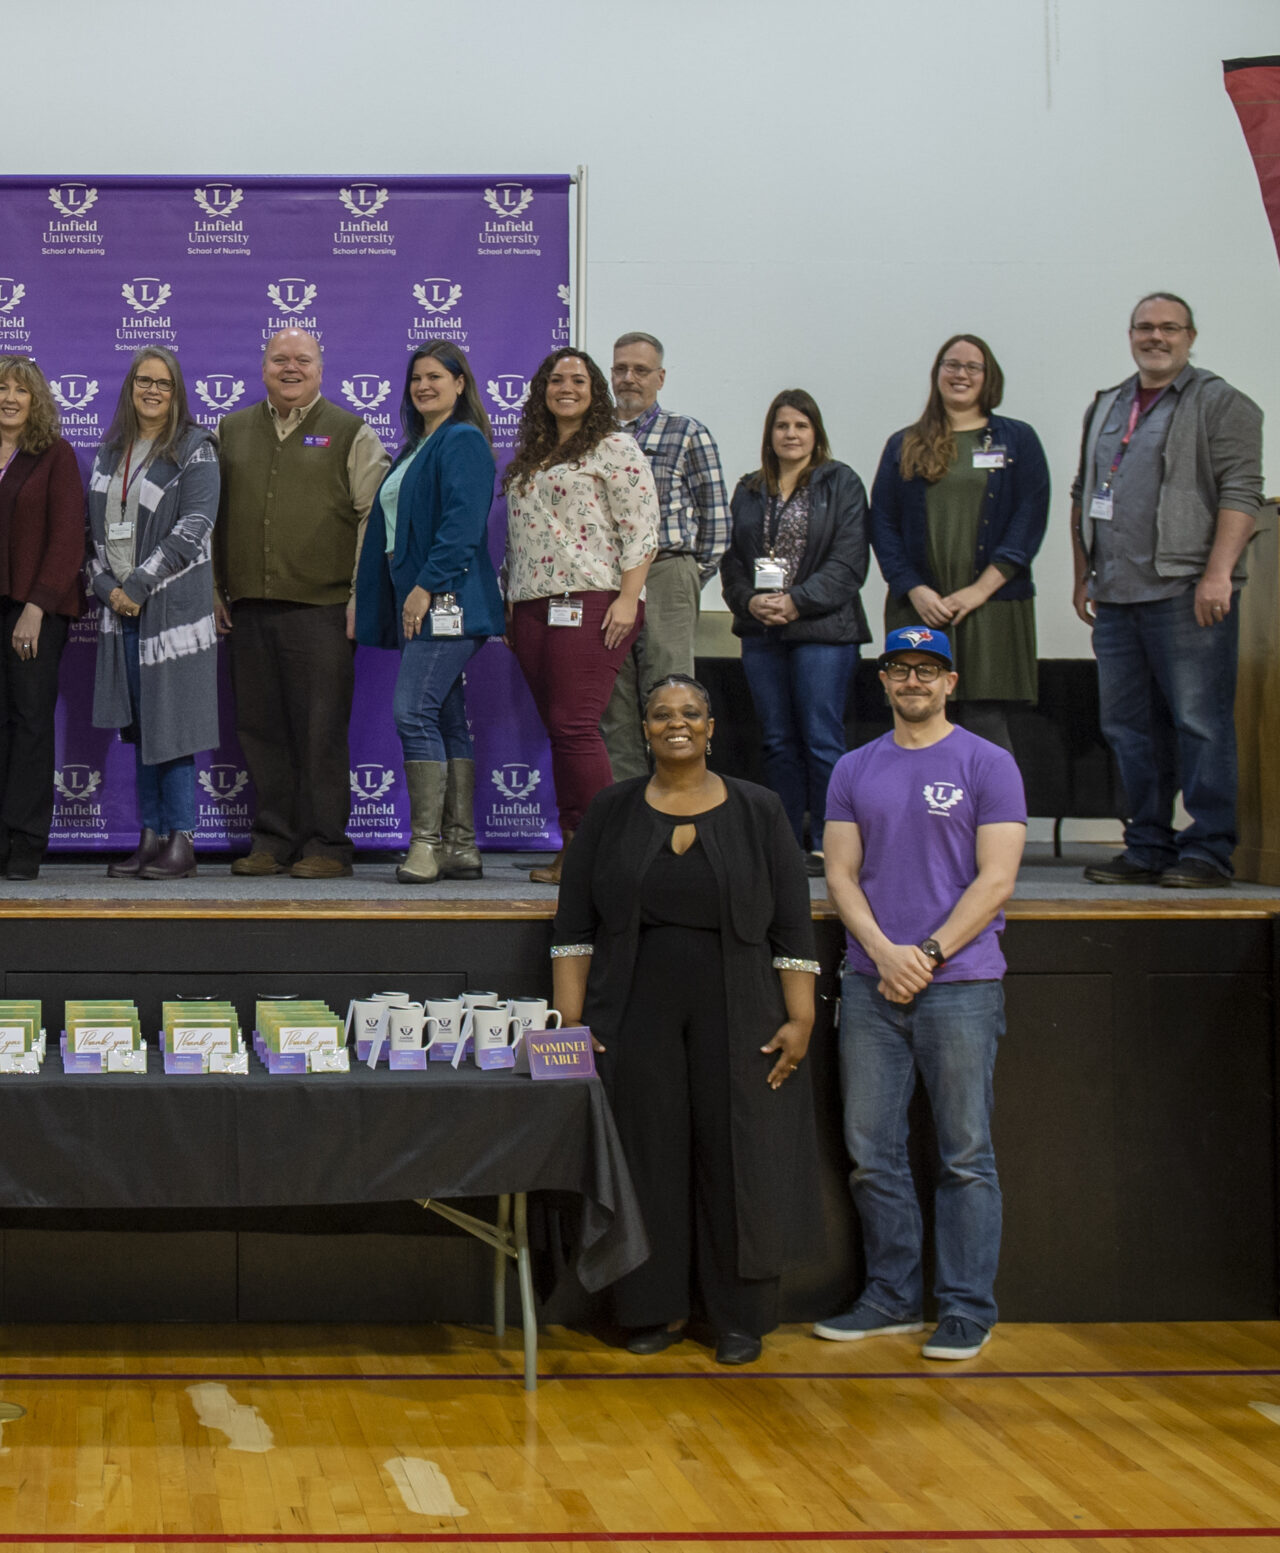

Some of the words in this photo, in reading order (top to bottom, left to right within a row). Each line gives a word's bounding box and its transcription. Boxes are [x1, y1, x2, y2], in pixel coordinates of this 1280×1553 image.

[68, 190, 80, 205] L
[213, 190, 226, 205] L
[359, 191, 372, 206] L
[504, 191, 516, 206] L
[50, 220, 97, 231] Linfield
[195, 220, 242, 231] Linfield
[341, 221, 388, 231] Linfield
[485, 221, 533, 232] Linfield
[43, 233, 103, 245] University
[189, 233, 248, 245] University
[334, 233, 394, 245] University
[479, 233, 539, 245] University
[77, 248, 105, 256] Nursing
[222, 248, 250, 256] Nursing
[333, 248, 358, 256] School
[359, 248, 367, 256] of
[368, 248, 396, 257] Nursing
[478, 248, 503, 256] School
[504, 248, 512, 256] of
[513, 248, 541, 257] Nursing
[141, 286, 154, 301] L
[287, 287, 300, 302] L
[432, 287, 444, 302] L
[123, 316, 170, 327] Linfield
[269, 317, 316, 328] Linfield
[414, 317, 461, 328] Linfield
[116, 329, 176, 341] University
[408, 329, 467, 342] University
[4, 344, 32, 353] Nursing
[69, 382, 81, 398] L
[215, 382, 227, 397] L
[361, 382, 373, 398] L
[505, 382, 517, 398] L
[72, 772, 84, 788] L
[218, 772, 230, 788] L
[365, 771, 377, 788] L
[511, 771, 523, 787] L
[936, 787, 947, 801] L
[53, 804, 101, 815] Linfield
[200, 804, 248, 815] Linfield
[493, 803, 540, 814] Linfield
[349, 817, 400, 828] niversity
[487, 816, 546, 828] University
[80, 832, 108, 840] Nursing
[374, 832, 402, 840] Nursing
[520, 832, 549, 840] Nursing
[77, 1030, 114, 1050] Thank
[176, 1030, 212, 1050] Thank
[282, 1030, 319, 1050] Thank
[532, 1041, 588, 1054] NOMINEE
[543, 1054, 580, 1066] TABLE
